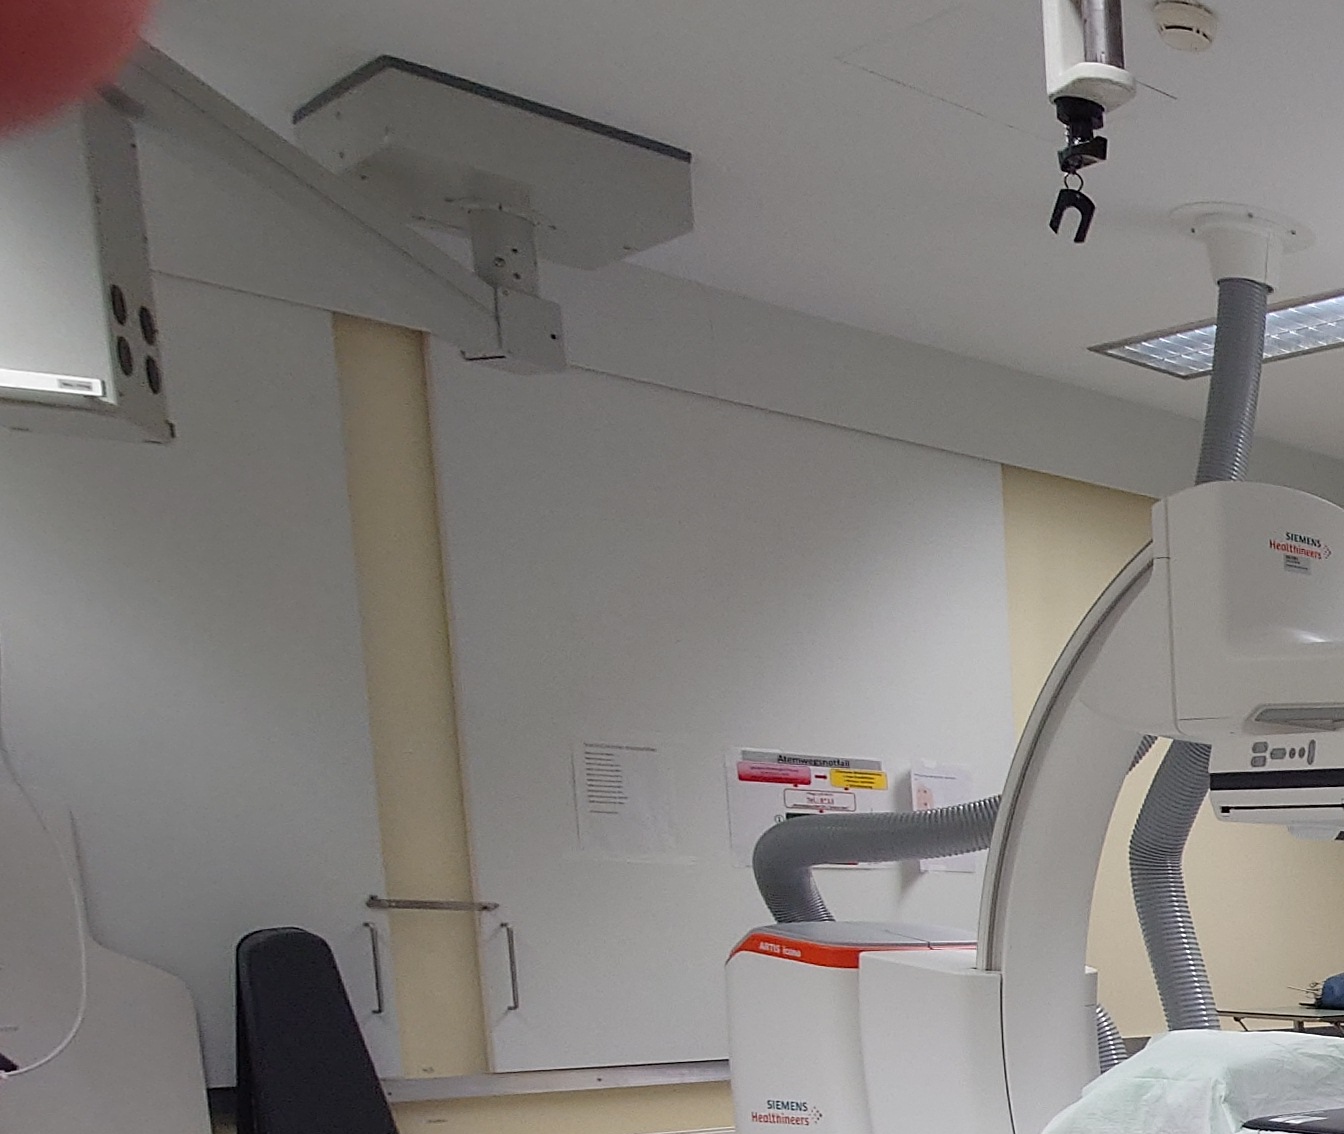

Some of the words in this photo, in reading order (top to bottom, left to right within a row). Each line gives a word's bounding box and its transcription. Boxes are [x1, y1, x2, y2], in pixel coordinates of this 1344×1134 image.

[1285, 531, 1322, 548] SIEMENS
[1269, 539, 1322, 560] Healthineers
[767, 1099, 808, 1112] SIEMENS
[751, 1111, 810, 1126] Healthineers
